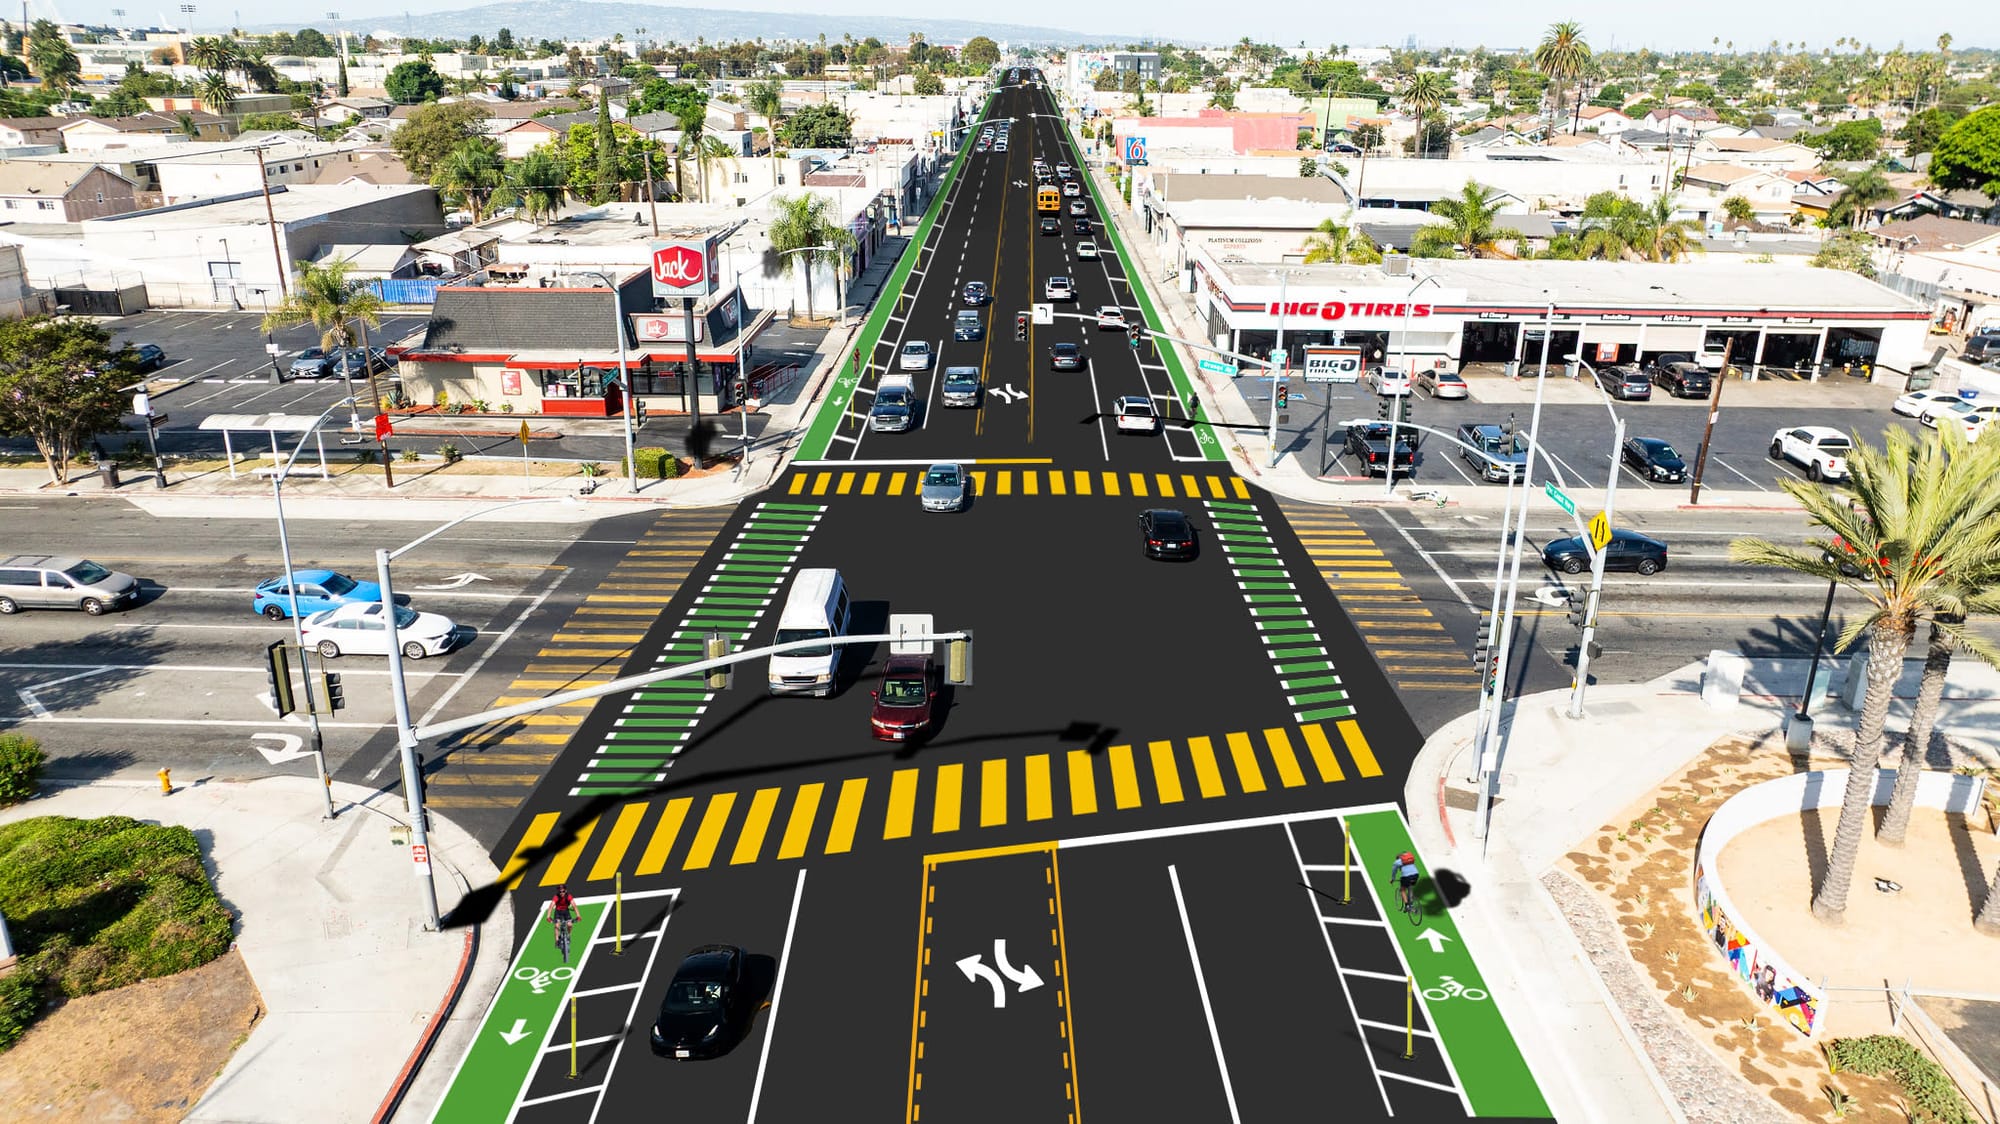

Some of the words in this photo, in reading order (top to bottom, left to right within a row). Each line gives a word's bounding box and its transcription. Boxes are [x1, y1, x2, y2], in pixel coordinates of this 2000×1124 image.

[1131, 140, 1143, 159] 6
[655, 250, 701, 281] Jack
[1270, 302, 1319, 316] BIG
[1348, 302, 1431, 317] TIRES
[1309, 359, 1339, 368] BIG
